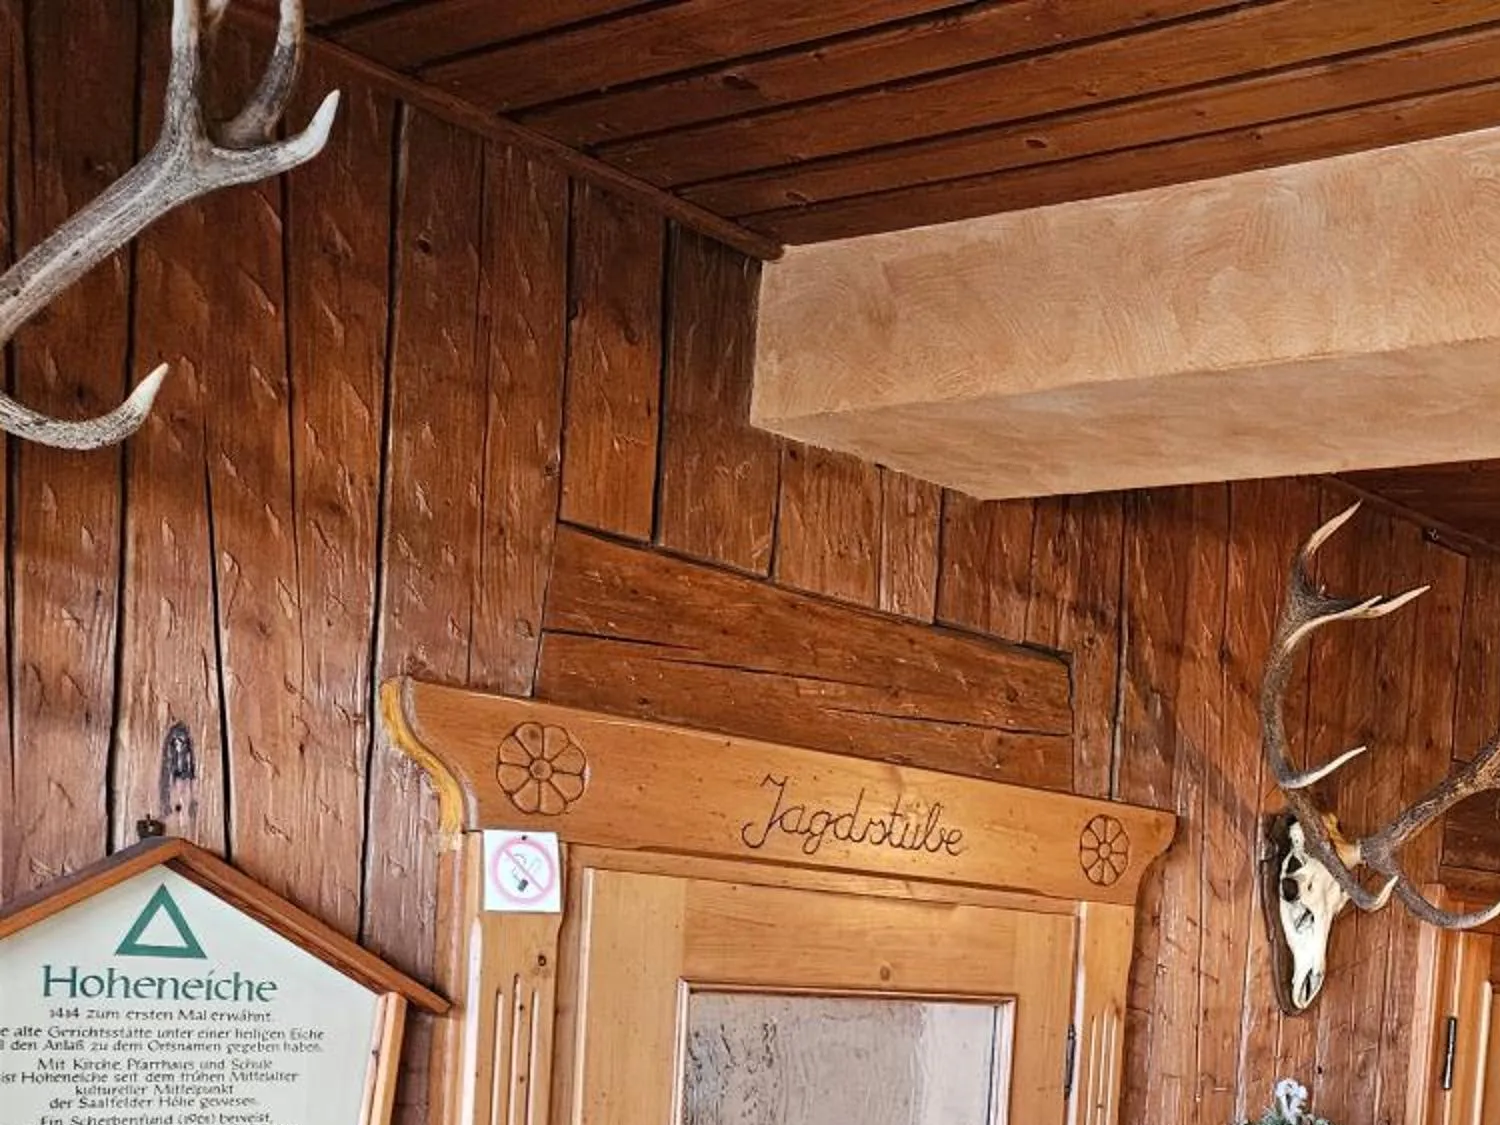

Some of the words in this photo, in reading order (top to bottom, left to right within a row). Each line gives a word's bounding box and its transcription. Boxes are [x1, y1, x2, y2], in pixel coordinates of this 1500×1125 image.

[42, 964, 278, 1002] Hoheneiche
[86, 1009, 120, 1019] zum
[125, 1009, 174, 1021] ersten
[177, 1008, 207, 1020] Mal
[13, 1025, 43, 1038] alte
[157, 1027, 194, 1039] unter
[197, 1028, 230, 1040] einer
[235, 1027, 285, 1041] heiligen
[290, 1027, 325, 1040] Eiche
[10, 1039, 38, 1051] den
[90, 1041, 108, 1051] zu
[112, 1040, 145, 1051] dem
[147, 1040, 221, 1052] Ortsnamen
[227, 1041, 280, 1054] gegeben
[37, 1057, 66, 1071] Mit
[127, 1057, 195, 1070] Pfarrhaus
[200, 1058, 225, 1069] und
[231, 1057, 273, 1070] Schule
[21, 1071, 109, 1084] Hoheneiche
[114, 1072, 137, 1083] seit
[145, 1072, 175, 1083] dem
[229, 1071, 299, 1082] Mittelalter
[75, 1084, 148, 1096] kultureller
[153, 1083, 234, 1096] Mittelpunkt
[49, 1098, 73, 1109] der
[77, 1096, 152, 1109] Saalfelder
